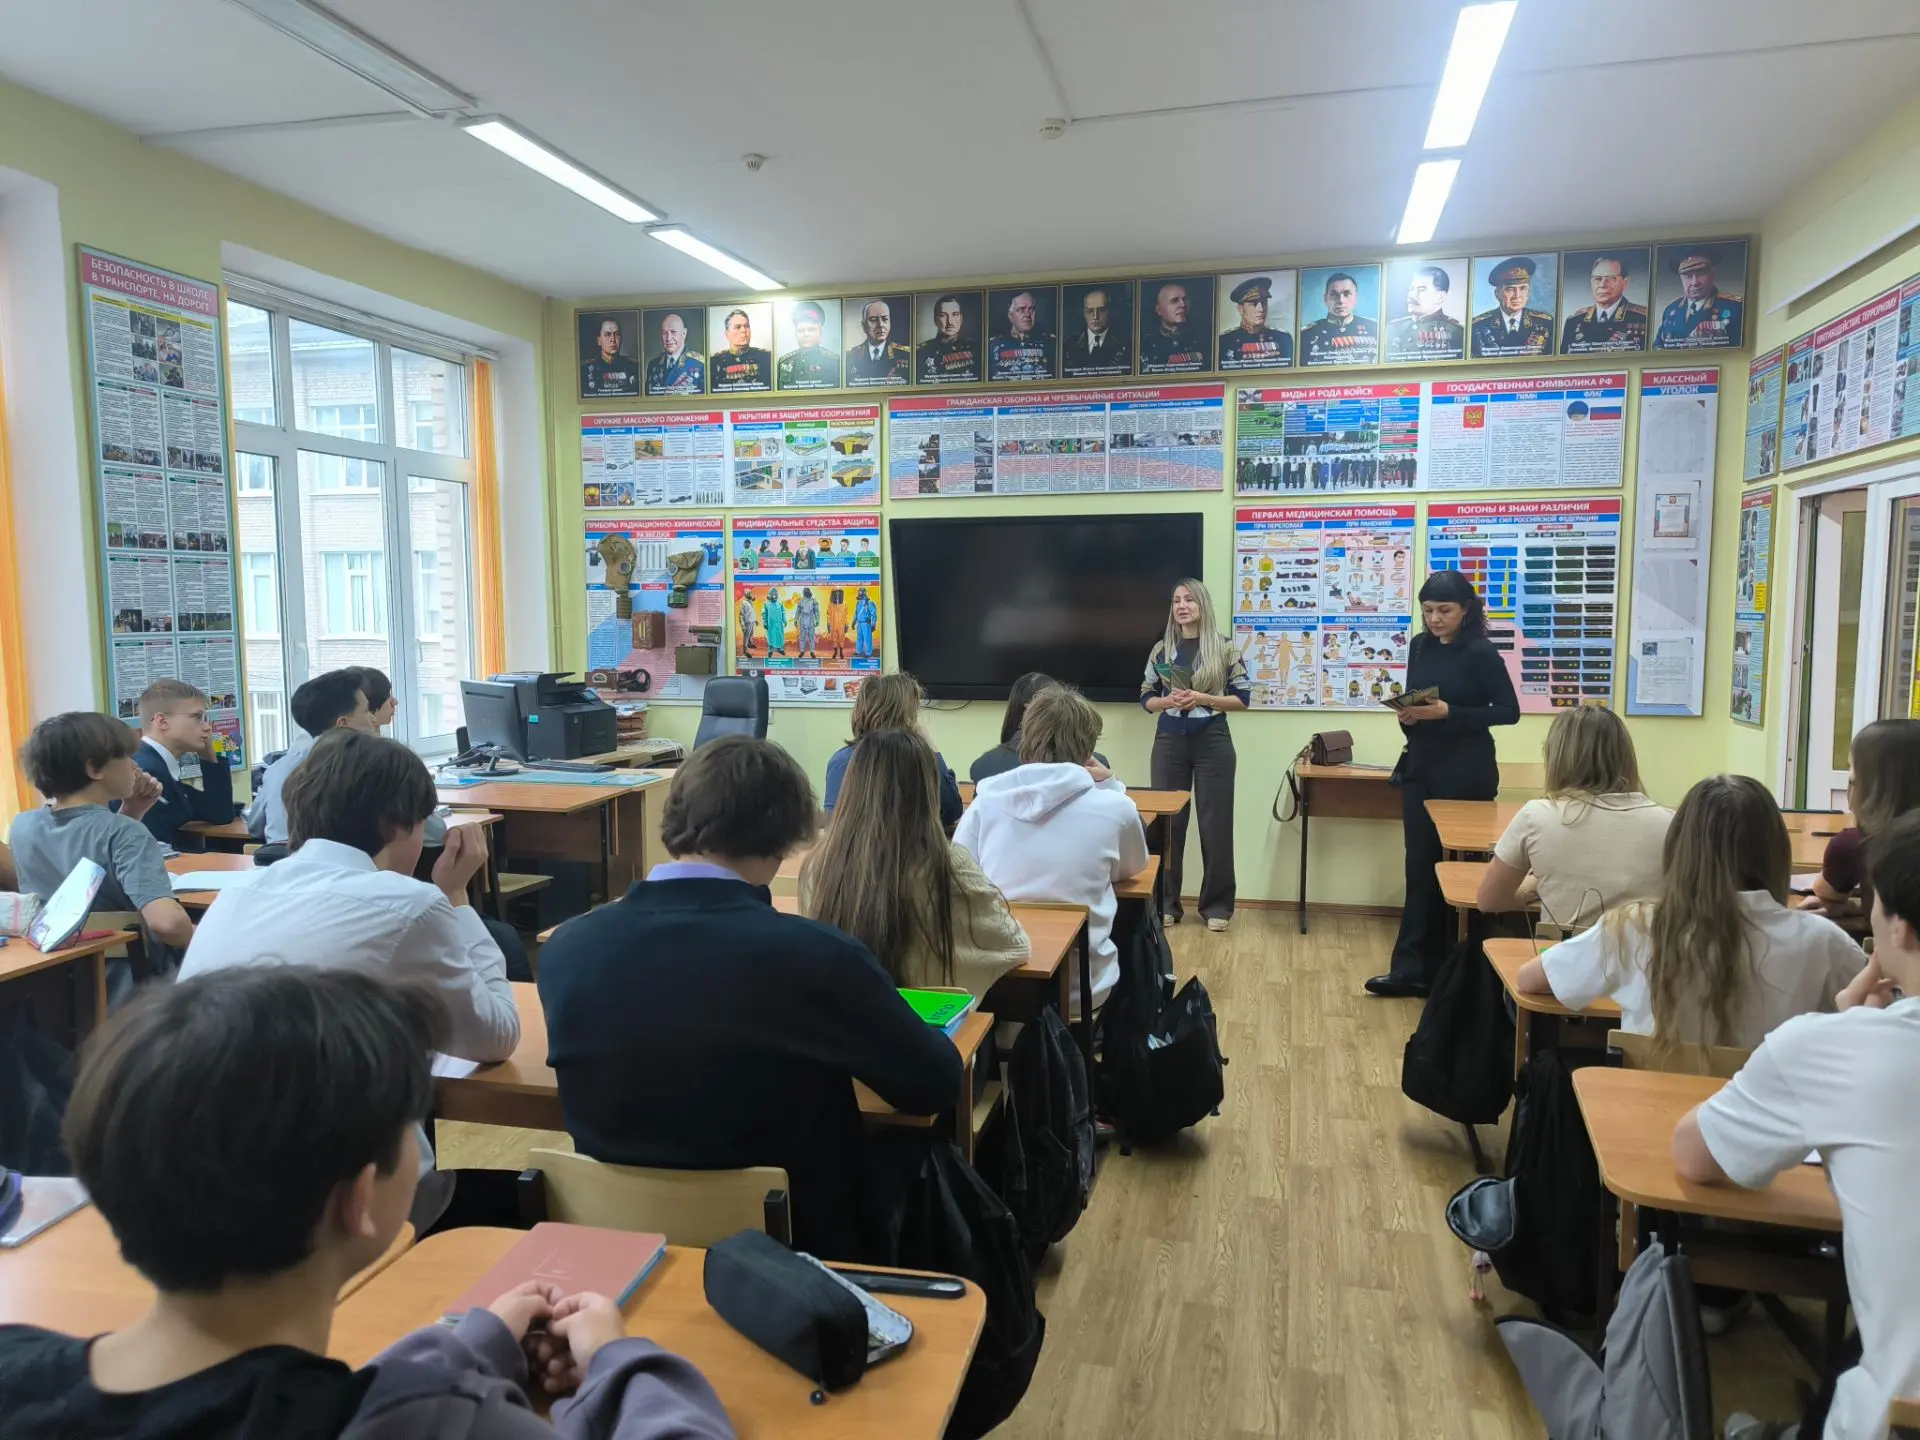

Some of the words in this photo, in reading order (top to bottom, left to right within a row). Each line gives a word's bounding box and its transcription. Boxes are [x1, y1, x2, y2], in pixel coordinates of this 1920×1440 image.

[91, 258, 167, 288] БЕЗОПАСНОСТЬ
[169, 282, 175, 291] В
[177, 284, 212, 302] ШКОЛЕ,
[91, 272, 98, 281] В
[163, 292, 176, 302] НА
[178, 295, 210, 312] ДОРОГЕ
[1653, 373, 1707, 384] КЛАССНЫЙ
[1446, 382, 1534, 393] ГОСУДАРСТВЕННАЯ
[1536, 378, 1597, 388] СИМВОЛИКА
[1660, 386, 1699, 395] УГОЛОК
[947, 397, 1002, 406] ГРАЖДАНСКАЯ
[1003, 396, 1041, 404] ОБОРОНА
[1043, 395, 1050, 403] И
[1051, 391, 1114, 401] ЧРЕЗВЫЧАЙНЫЕ
[1117, 390, 1160, 400] СИТУАЦИИ
[1281, 391, 1307, 400] ВИДЫ
[1317, 389, 1342, 398] РОДА
[1343, 386, 1374, 396] ВОЙСК
[1583, 390, 1604, 398] ФЛАГ
[623, 416, 665, 424] МАССОВОГО
[666, 414, 709, 423] ПОРАЖЕНИЯ
[738, 413, 771, 421] УКРЫТИЯ
[780, 410, 819, 420] ЗАЩИТНЫЕ
[821, 408, 871, 418] СООРУЖЕНИЯ
[1251, 511, 1283, 519] ПЕРВАЯ
[1285, 509, 1352, 519] МЕДИЦИНСКАЯ
[1355, 508, 1398, 517] ПОМОЩЬ
[1457, 505, 1497, 514] ПОГОНЫ
[1508, 504, 1538, 513] ЗНАКИ
[1540, 503, 1590, 512] РАЗЛИЧИЯ
[586, 521, 619, 529] ПРИБОРЫ
[620, 519, 720, 529] РАДИАЦИОННО-ХИМИЧЕСКОЙ
[736, 519, 804, 529] ИНДИВИДУАЛЬНЫЕ
[806, 518, 840, 527] СРЕДСТВА
[842, 518, 875, 526] ЗАЩИТЫ
